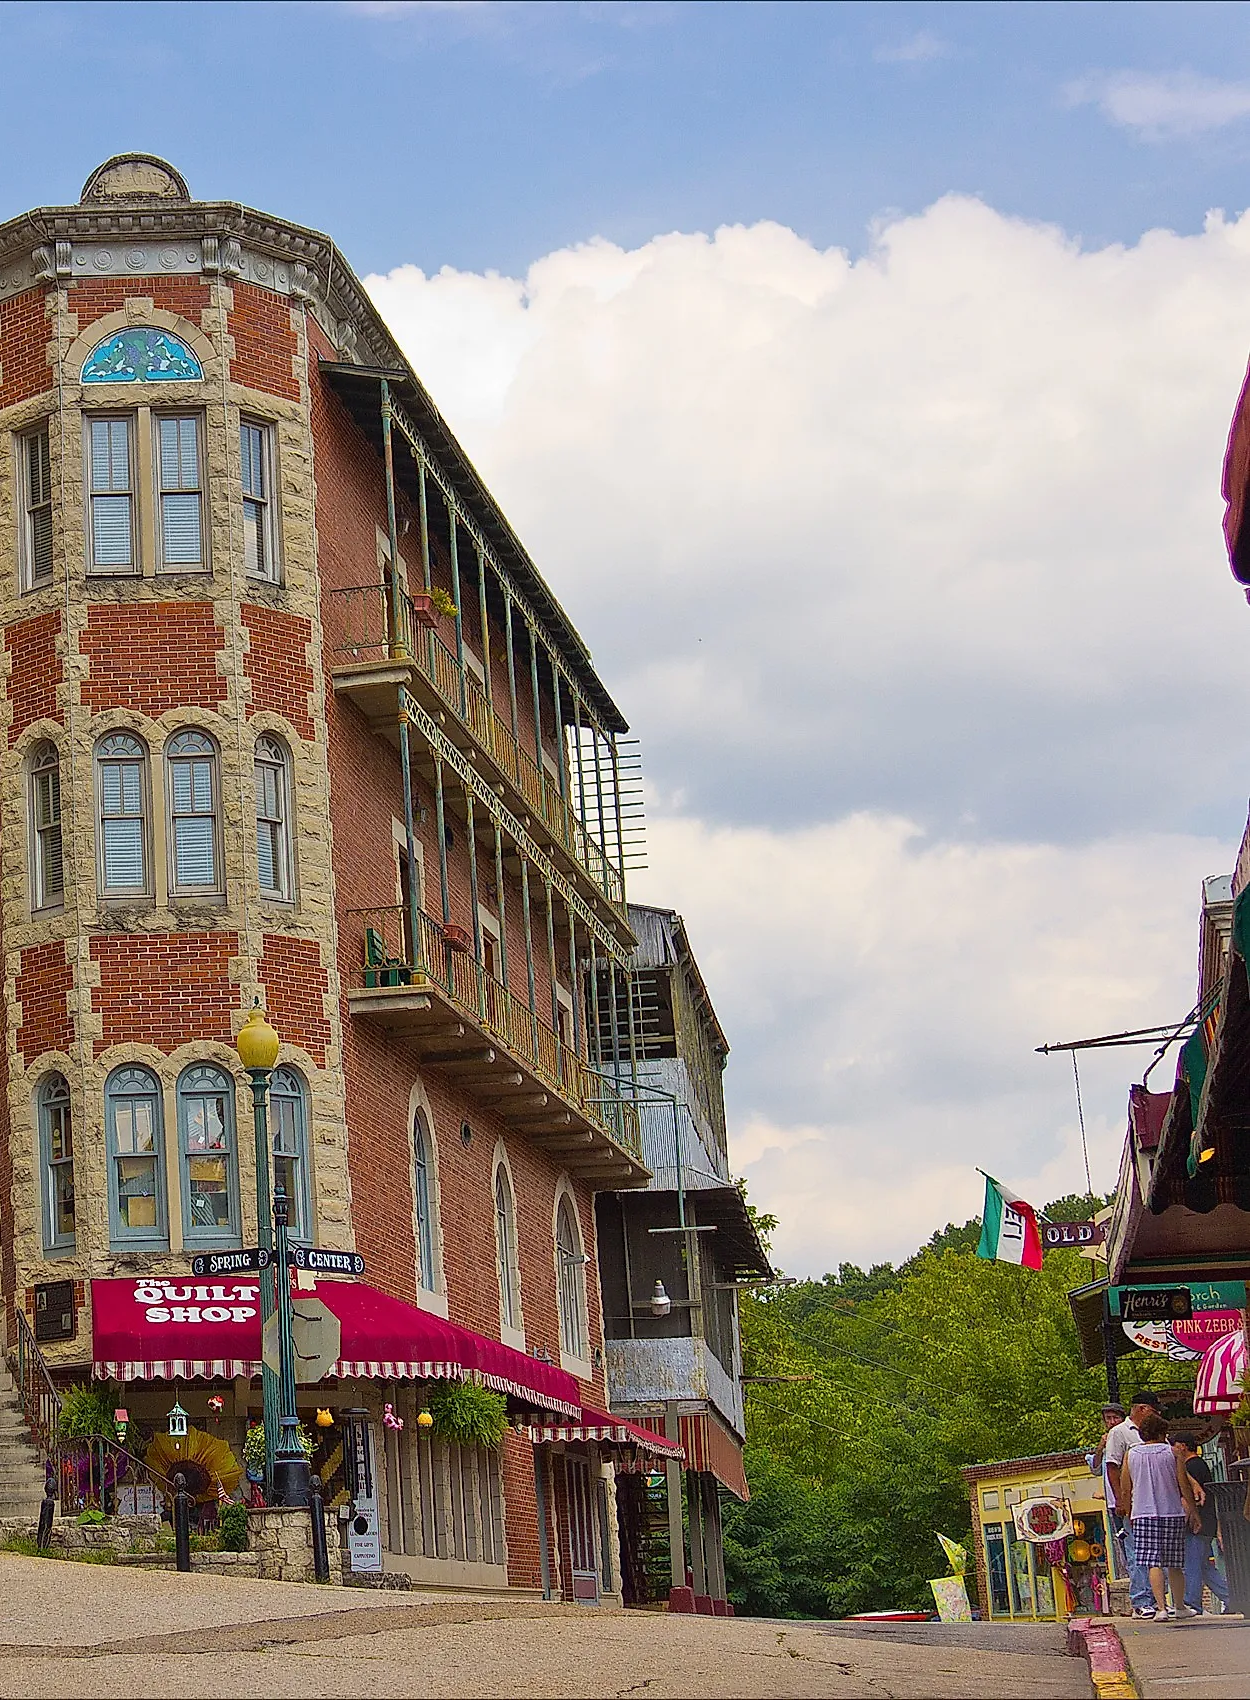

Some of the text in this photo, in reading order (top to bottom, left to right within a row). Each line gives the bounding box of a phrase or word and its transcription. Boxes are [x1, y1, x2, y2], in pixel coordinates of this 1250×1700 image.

[1046, 1225, 1092, 1243] OLD
[210, 1253, 251, 1272] SPRING
[308, 1251, 352, 1271] CENTER
[136, 1279, 170, 1287] The
[133, 1286, 260, 1304] QUILT
[1187, 1285, 1221, 1300] orch
[1124, 1293, 1169, 1318] Henri's
[145, 1307, 256, 1323] SHOP
[1176, 1319, 1203, 1334] PINK
[1206, 1318, 1243, 1332] ZEBRA
[1134, 1332, 1168, 1350] REST
